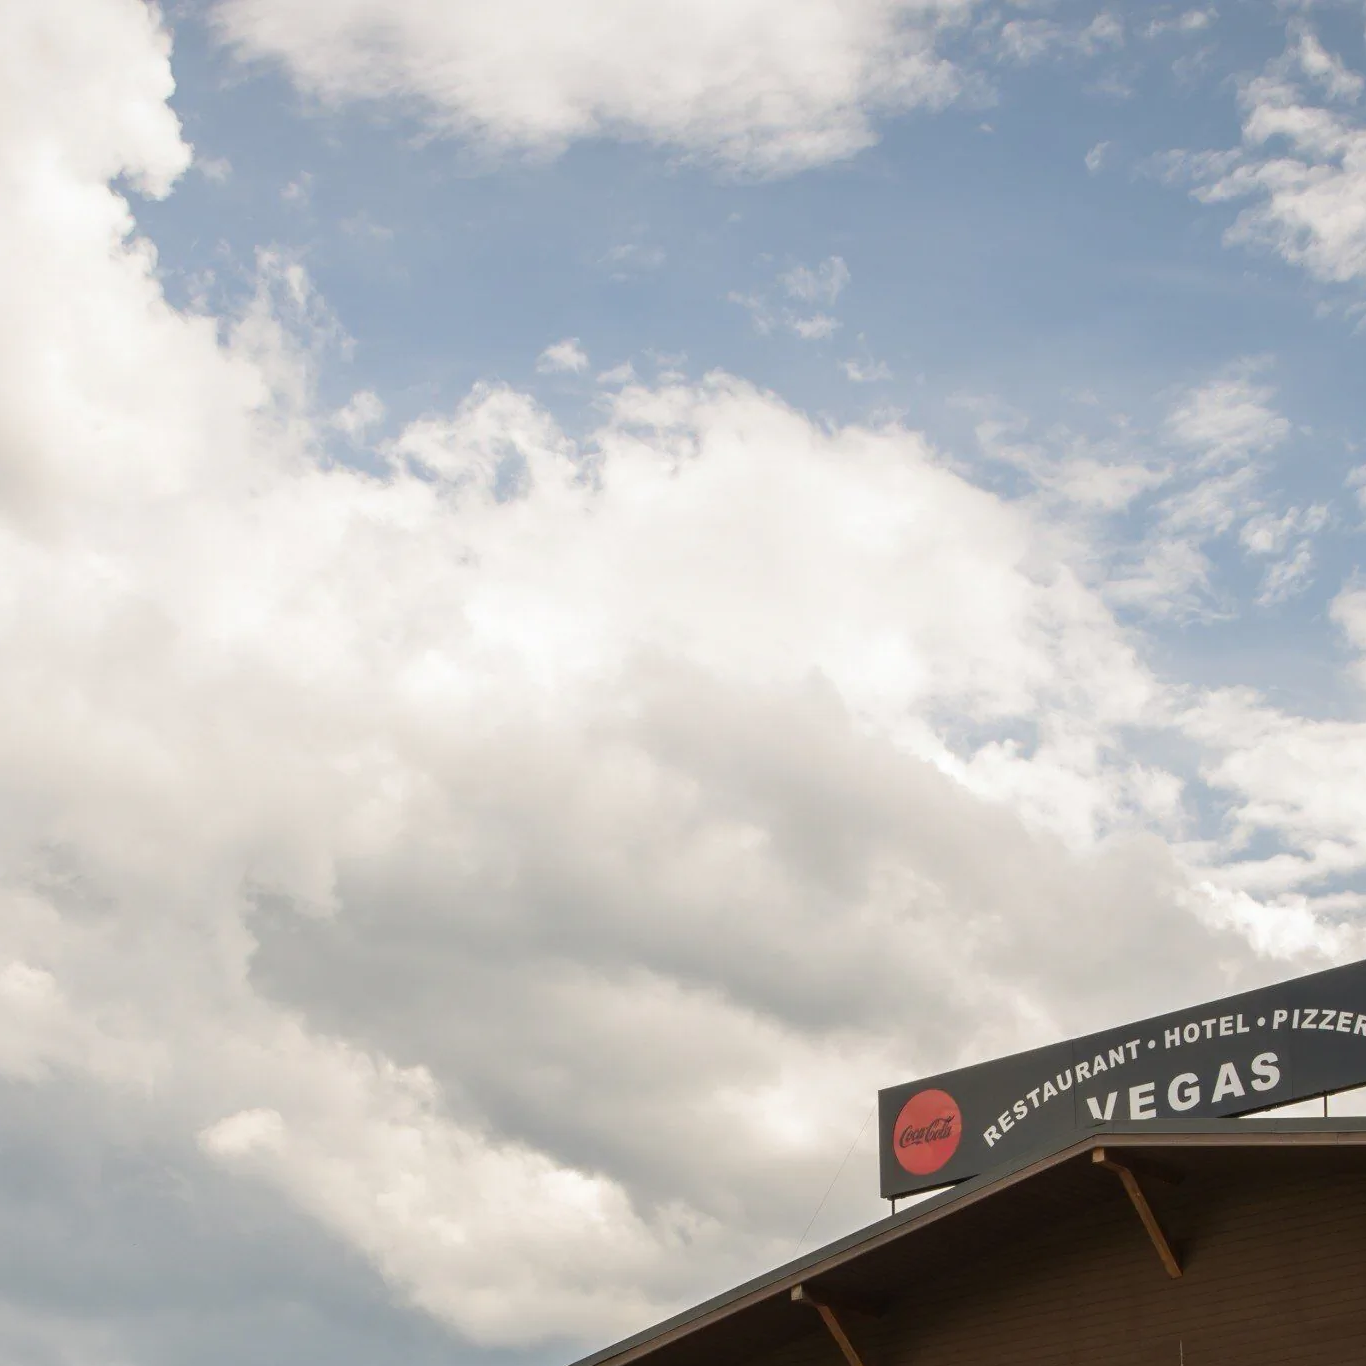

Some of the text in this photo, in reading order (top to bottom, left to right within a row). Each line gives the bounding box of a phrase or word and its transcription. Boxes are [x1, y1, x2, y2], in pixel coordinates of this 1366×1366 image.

[983, 1039, 1140, 1148] RESTAURANT
[1164, 1013, 1250, 1048] HOTEL
[1087, 1052, 1281, 1120] VEGAS
[899, 1115, 955, 1148] Coca-Cola
